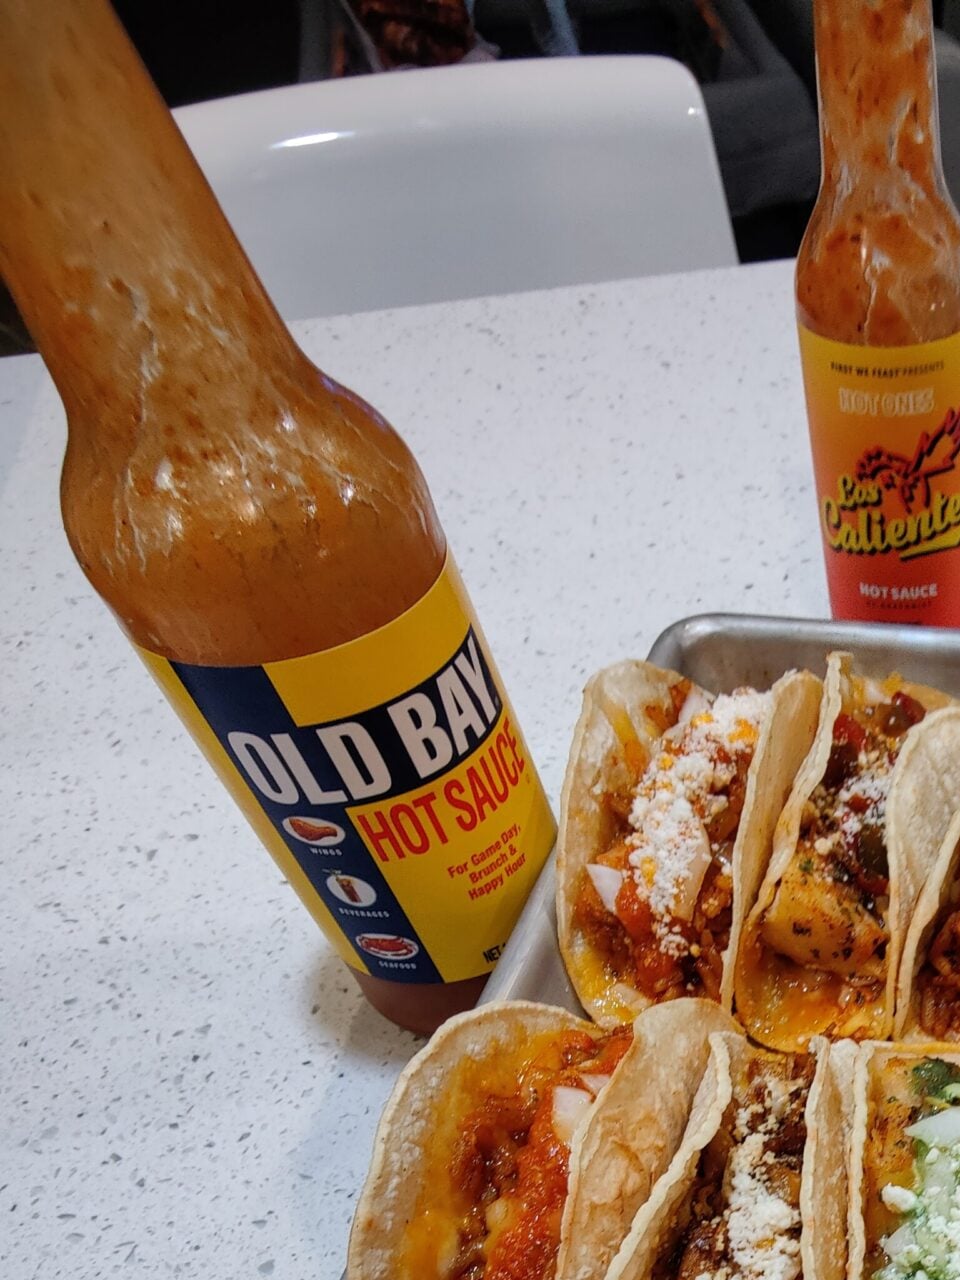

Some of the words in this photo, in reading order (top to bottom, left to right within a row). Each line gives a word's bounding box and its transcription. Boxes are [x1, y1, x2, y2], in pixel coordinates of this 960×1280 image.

[830, 360, 853, 375] FIRST
[855, 366, 869, 377] WE
[871, 366, 899, 378] FEAST
[902, 359, 944, 376] PRESENTS
[859, 581, 889, 600] HOT
[891, 582, 938, 600] SAUCE
[227, 721, 393, 806] OLD
[386, 634, 498, 779] BAY
[360, 792, 449, 863] HOT
[443, 716, 525, 832] SAUCE
[310, 847, 343, 856] WINGS
[447, 861, 469, 879] For
[470, 841, 502, 867] Game
[500, 823, 522, 845] Day,
[468, 853, 509, 885] Brunch
[509, 844, 517, 856] &
[468, 873, 505, 901] Happy
[504, 852, 527, 878] Hour
[338, 907, 390, 919] BEVERAGES
[378, 961, 417, 971] SEAFOOD
